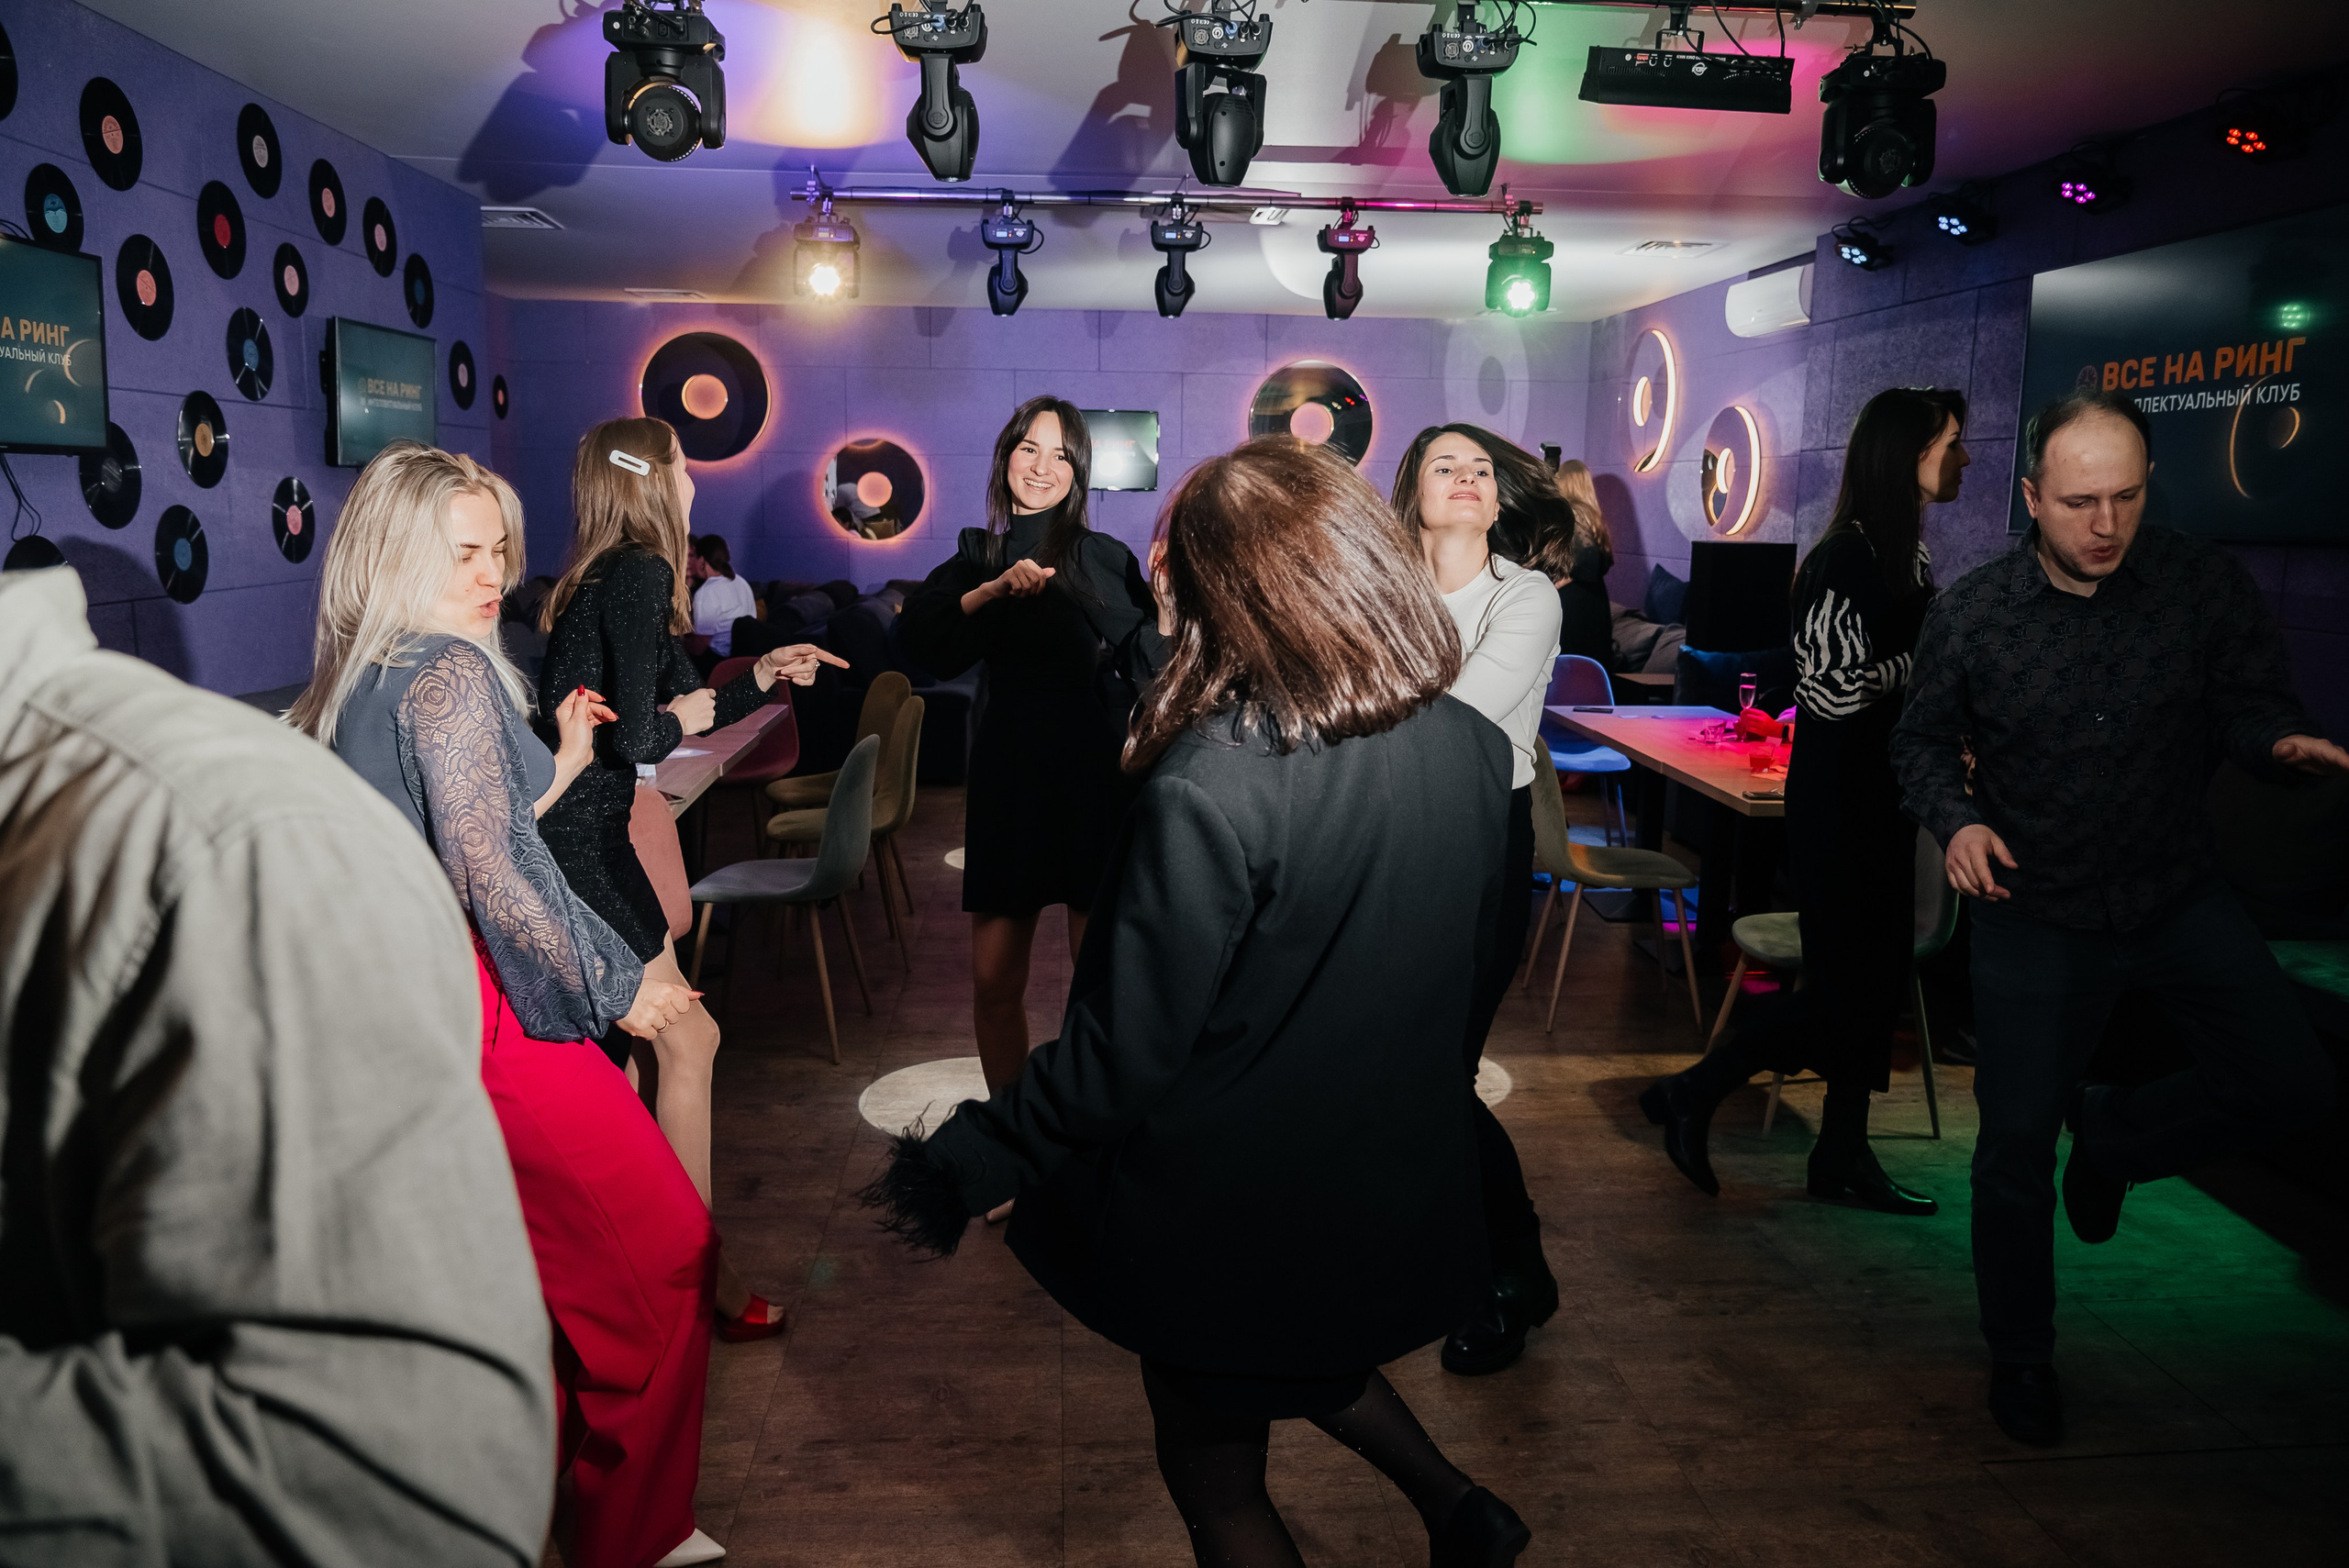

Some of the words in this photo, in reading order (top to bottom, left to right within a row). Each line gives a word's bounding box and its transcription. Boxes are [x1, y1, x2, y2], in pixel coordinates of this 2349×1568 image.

[1, 316, 16, 340] А
[19, 318, 70, 348] РИНГ
[0, 347, 46, 363] УАЛЬНЫЙ
[49, 352, 72, 366] КЛУБ
[2102, 356, 2156, 391] ВСЕ
[2164, 350, 2204, 384] НА
[2214, 337, 2307, 380] РИНГ
[2256, 384, 2300, 405] КЛУБ
